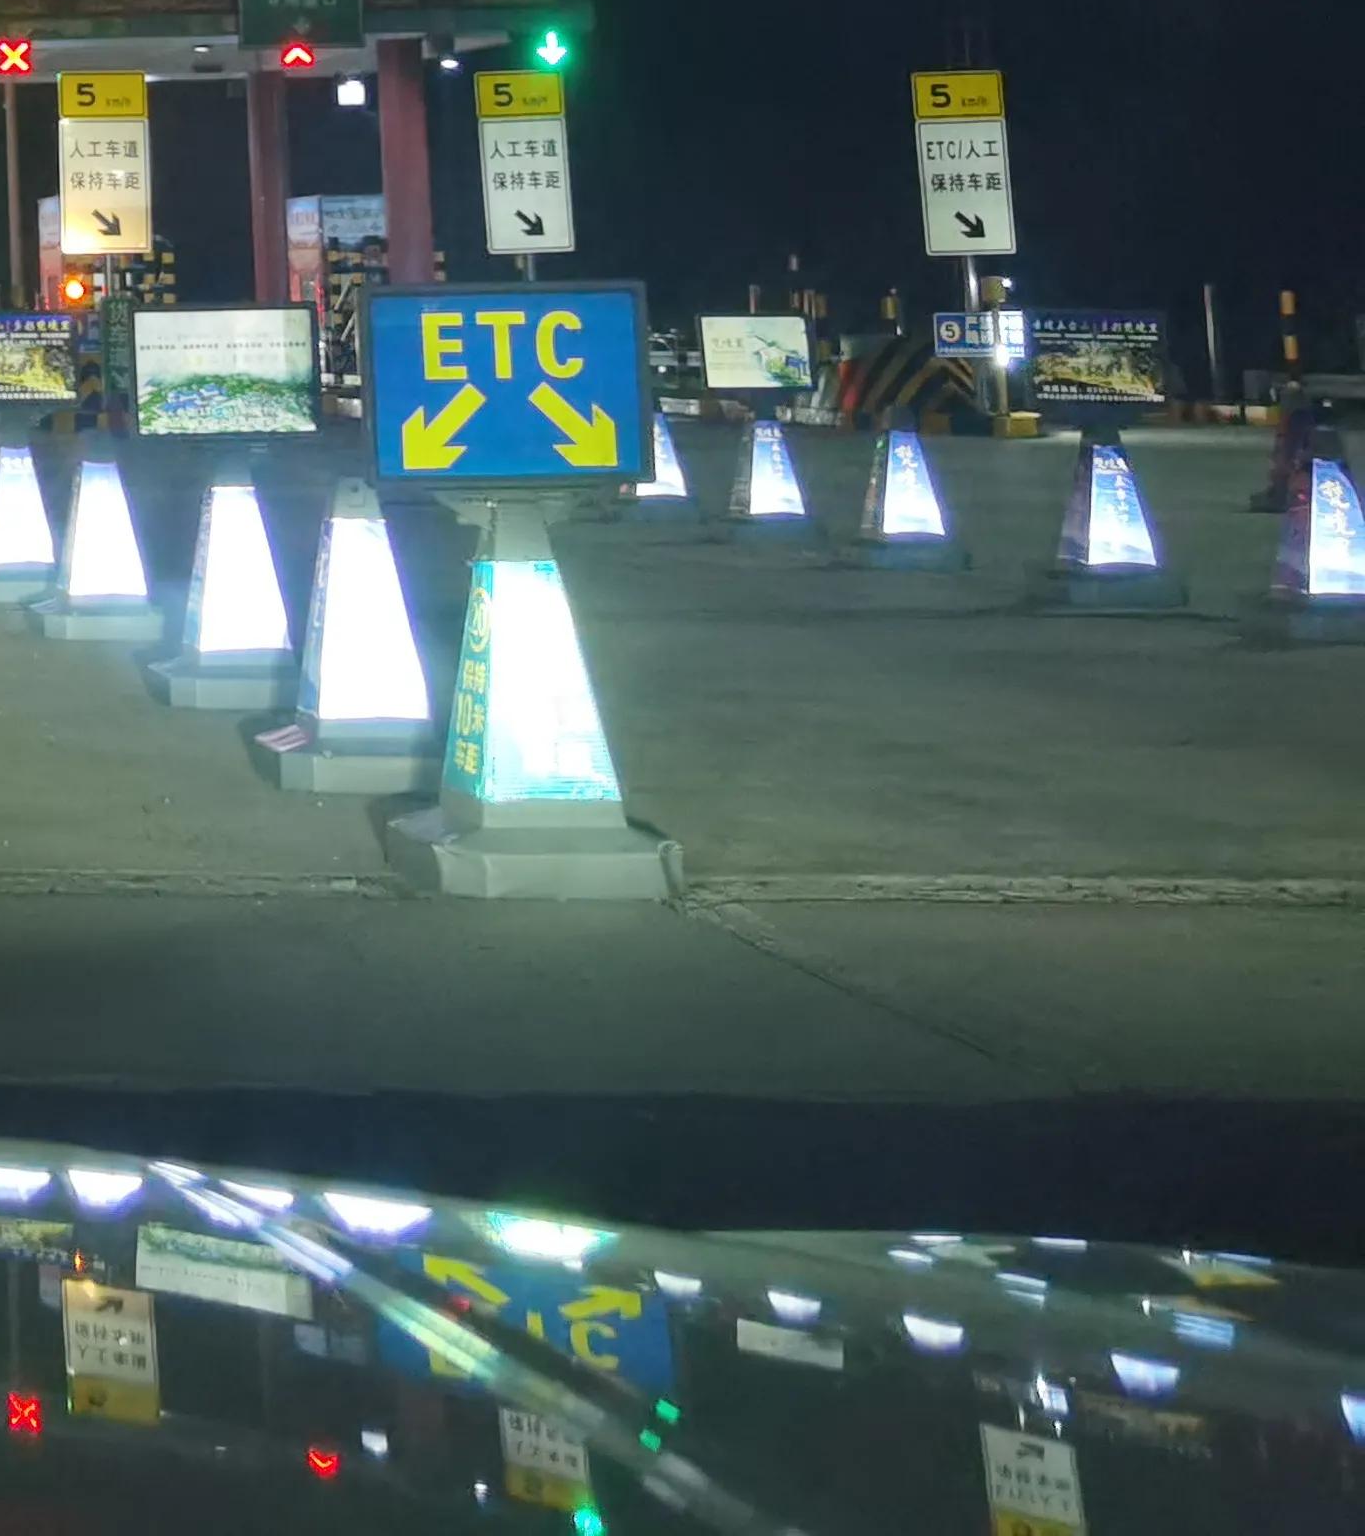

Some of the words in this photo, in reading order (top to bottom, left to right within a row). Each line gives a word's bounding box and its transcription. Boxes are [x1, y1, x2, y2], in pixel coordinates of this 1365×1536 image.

[76, 83, 97, 107] 5
[493, 83, 514, 107] 5
[930, 83, 952, 109] 5
[69, 139, 140, 159] 人工车道
[489, 138, 558, 160] 人工车道
[925, 139, 1000, 161] ETC/人工
[70, 170, 141, 191] 保持车距
[492, 170, 562, 191] 保持车距
[930, 172, 1003, 193] 保持车距
[420, 309, 584, 381] ETC
